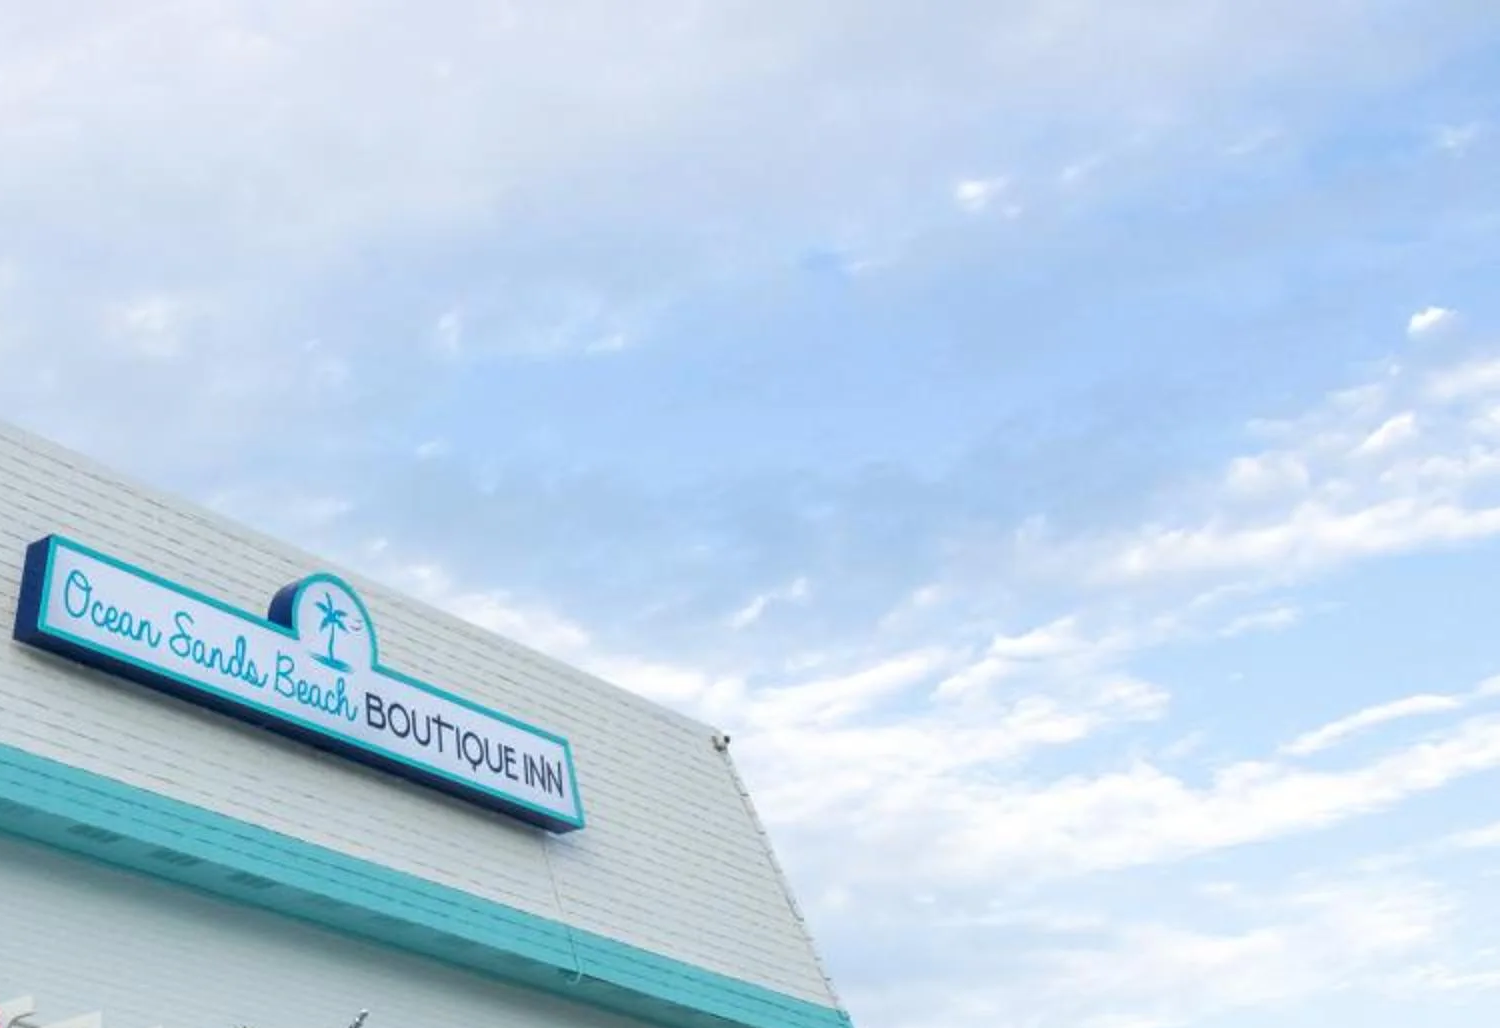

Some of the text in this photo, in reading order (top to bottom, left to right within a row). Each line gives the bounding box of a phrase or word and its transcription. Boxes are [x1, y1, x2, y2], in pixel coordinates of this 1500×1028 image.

[65, 569, 564, 798] Ocean Sands Beach BOUTIQUE INN
